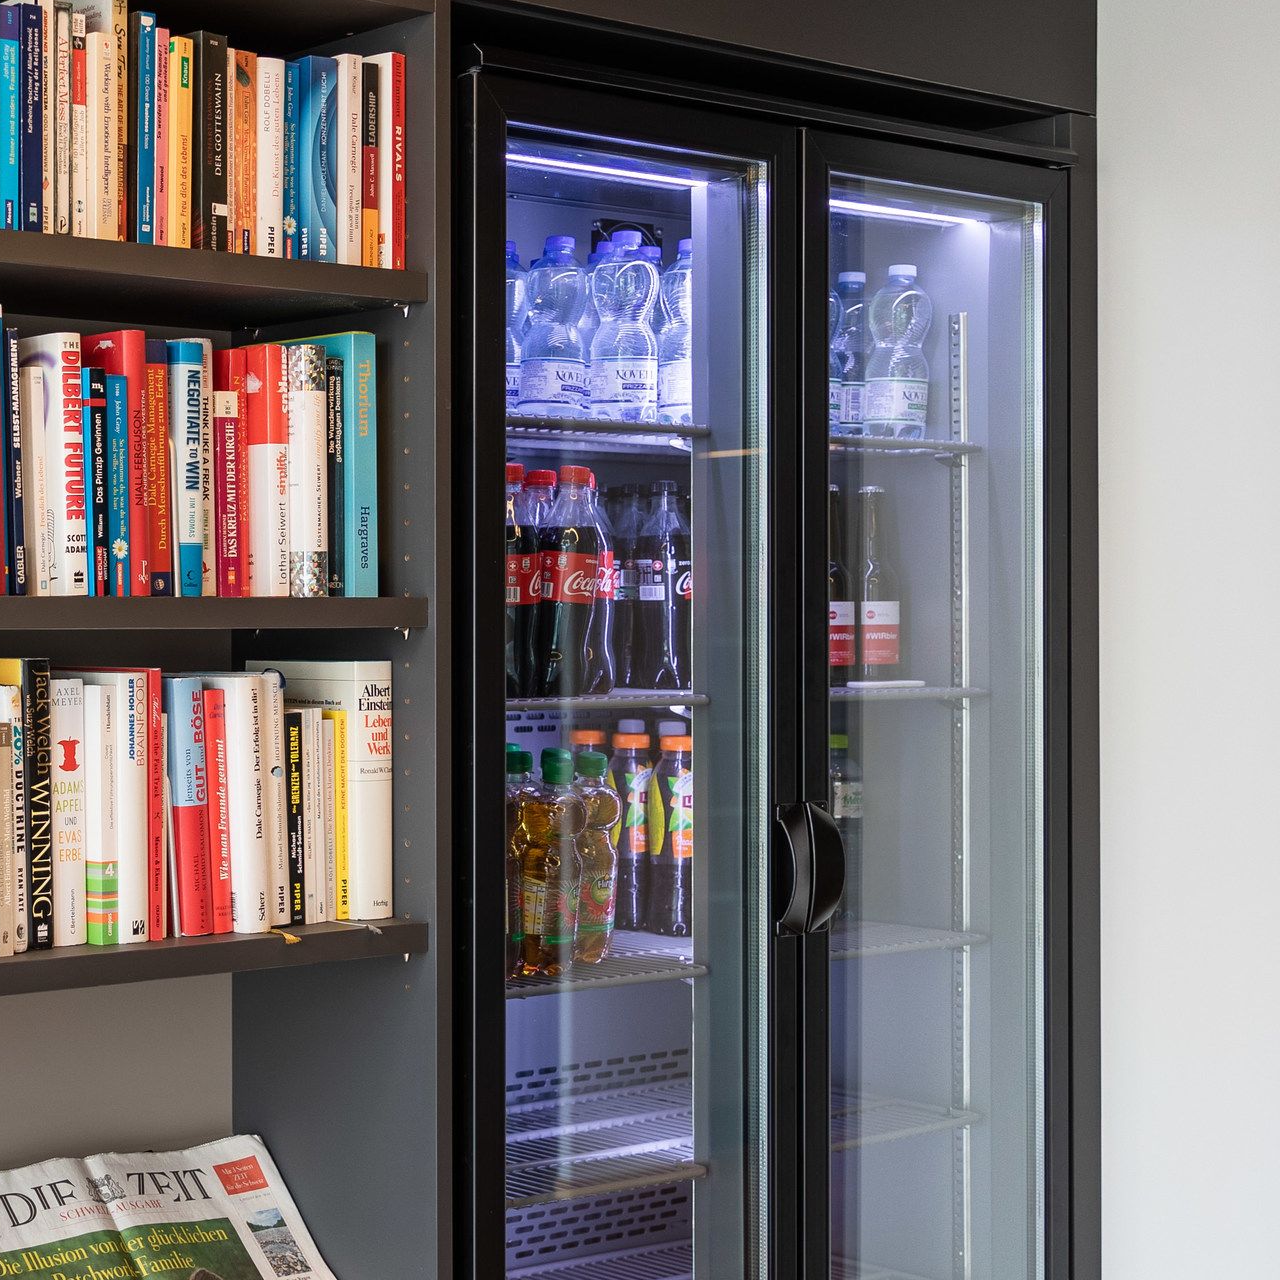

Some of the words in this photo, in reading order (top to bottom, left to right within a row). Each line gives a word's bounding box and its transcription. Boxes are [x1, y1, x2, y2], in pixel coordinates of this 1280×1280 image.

[214, 73, 222, 154] GOTTESWAHN
[214, 155, 222, 176] DER
[63, 341, 79, 349] THE
[12, 338, 20, 449] SELBST-MANAGEMENT
[61, 351, 82, 435] DILBERT
[187, 369, 200, 446] NEGOTIATE
[358, 360, 370, 437] Thorium
[63, 439, 85, 520] FUTURE
[186, 460, 200, 490] WIN
[189, 448, 198, 459] TO
[360, 506, 370, 570] Hargraves
[192, 690, 203, 744] BÖSE
[362, 684, 390, 698] Albert
[136, 677, 144, 767] BRAINFOOD
[368, 741, 391, 755] Werk
[372, 730, 388, 741] und
[196, 764, 206, 802] GUT
[31, 780, 52, 919] WINNING
[20, 1244, 88, 1270] Illusion
[92, 1238, 119, 1255] von
[149, 1227, 227, 1251] glücklichen
